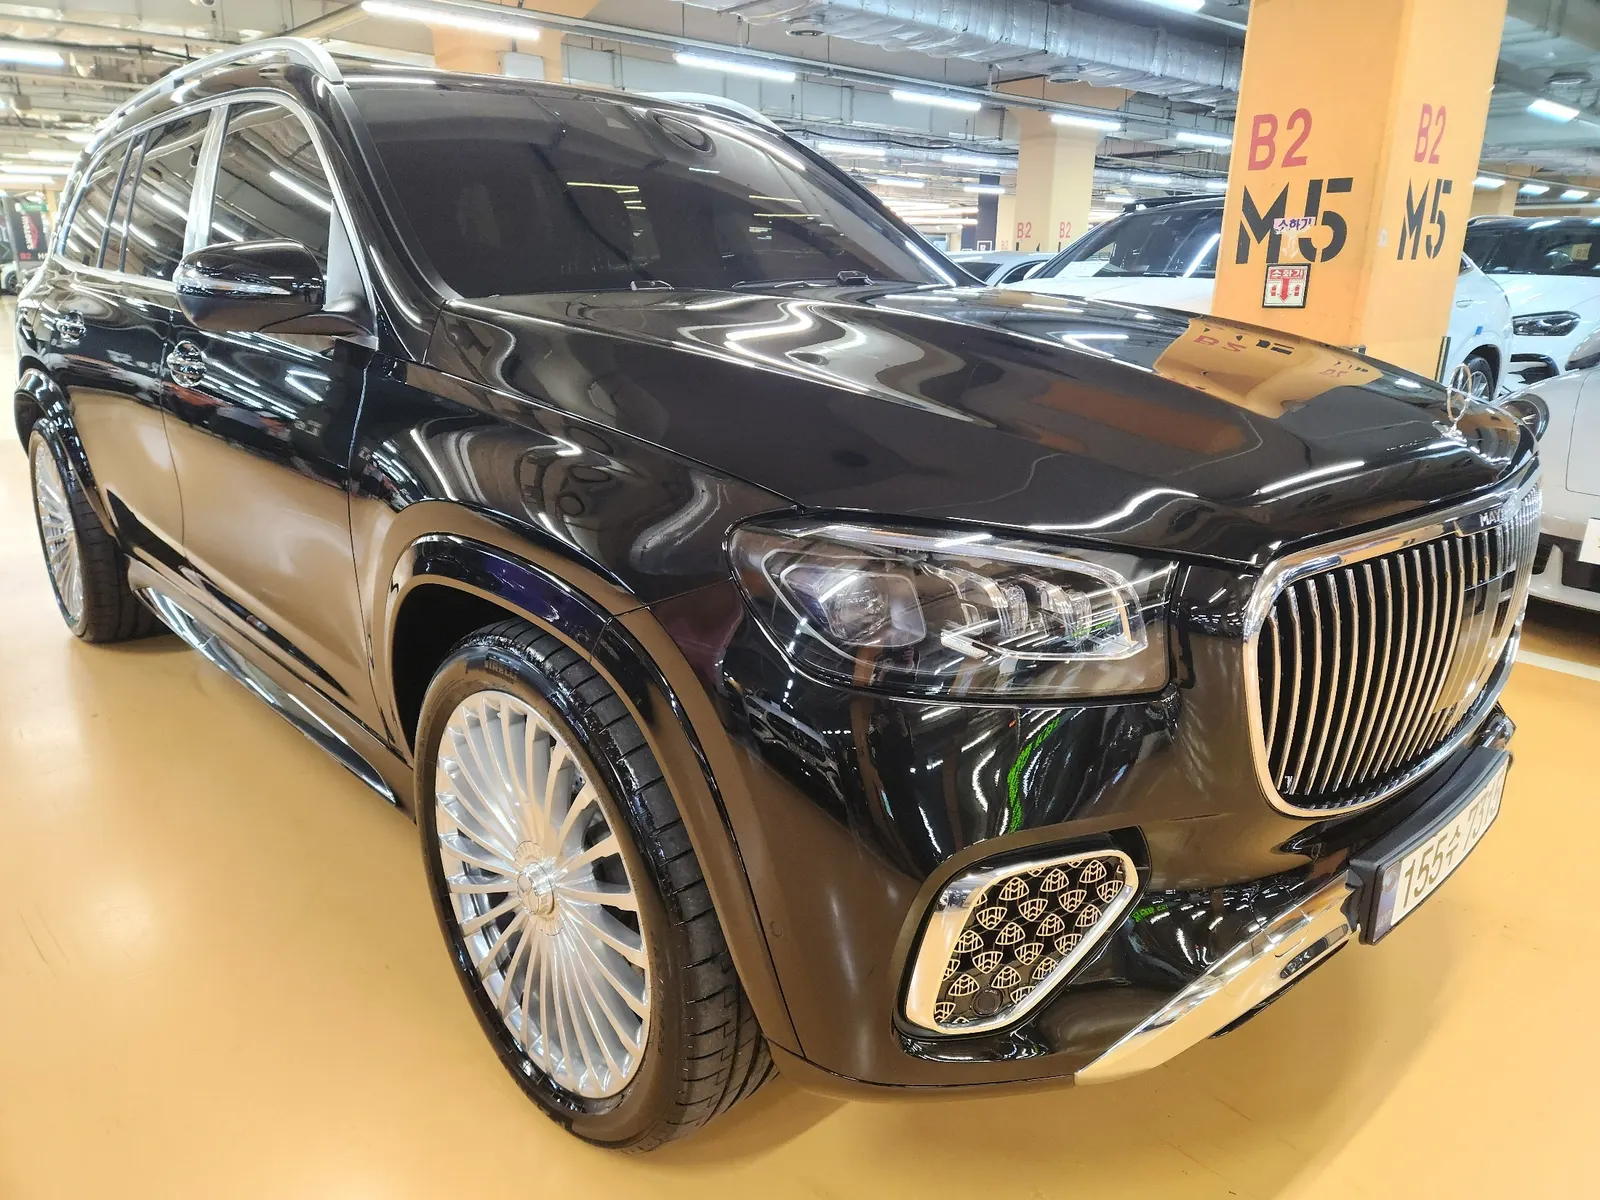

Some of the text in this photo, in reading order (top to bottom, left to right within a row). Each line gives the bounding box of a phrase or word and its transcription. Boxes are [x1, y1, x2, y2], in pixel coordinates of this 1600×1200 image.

[1247, 108, 1312, 171] B2
[1414, 103, 1446, 164] B2
[1017, 222, 1032, 239] B2
[1059, 222, 1071, 239] B2
[1235, 177, 1354, 264] M5
[1397, 178, 1453, 260] M5
[1271, 269, 1303, 278] 소화기
[1403, 824, 1461, 909] 155수
